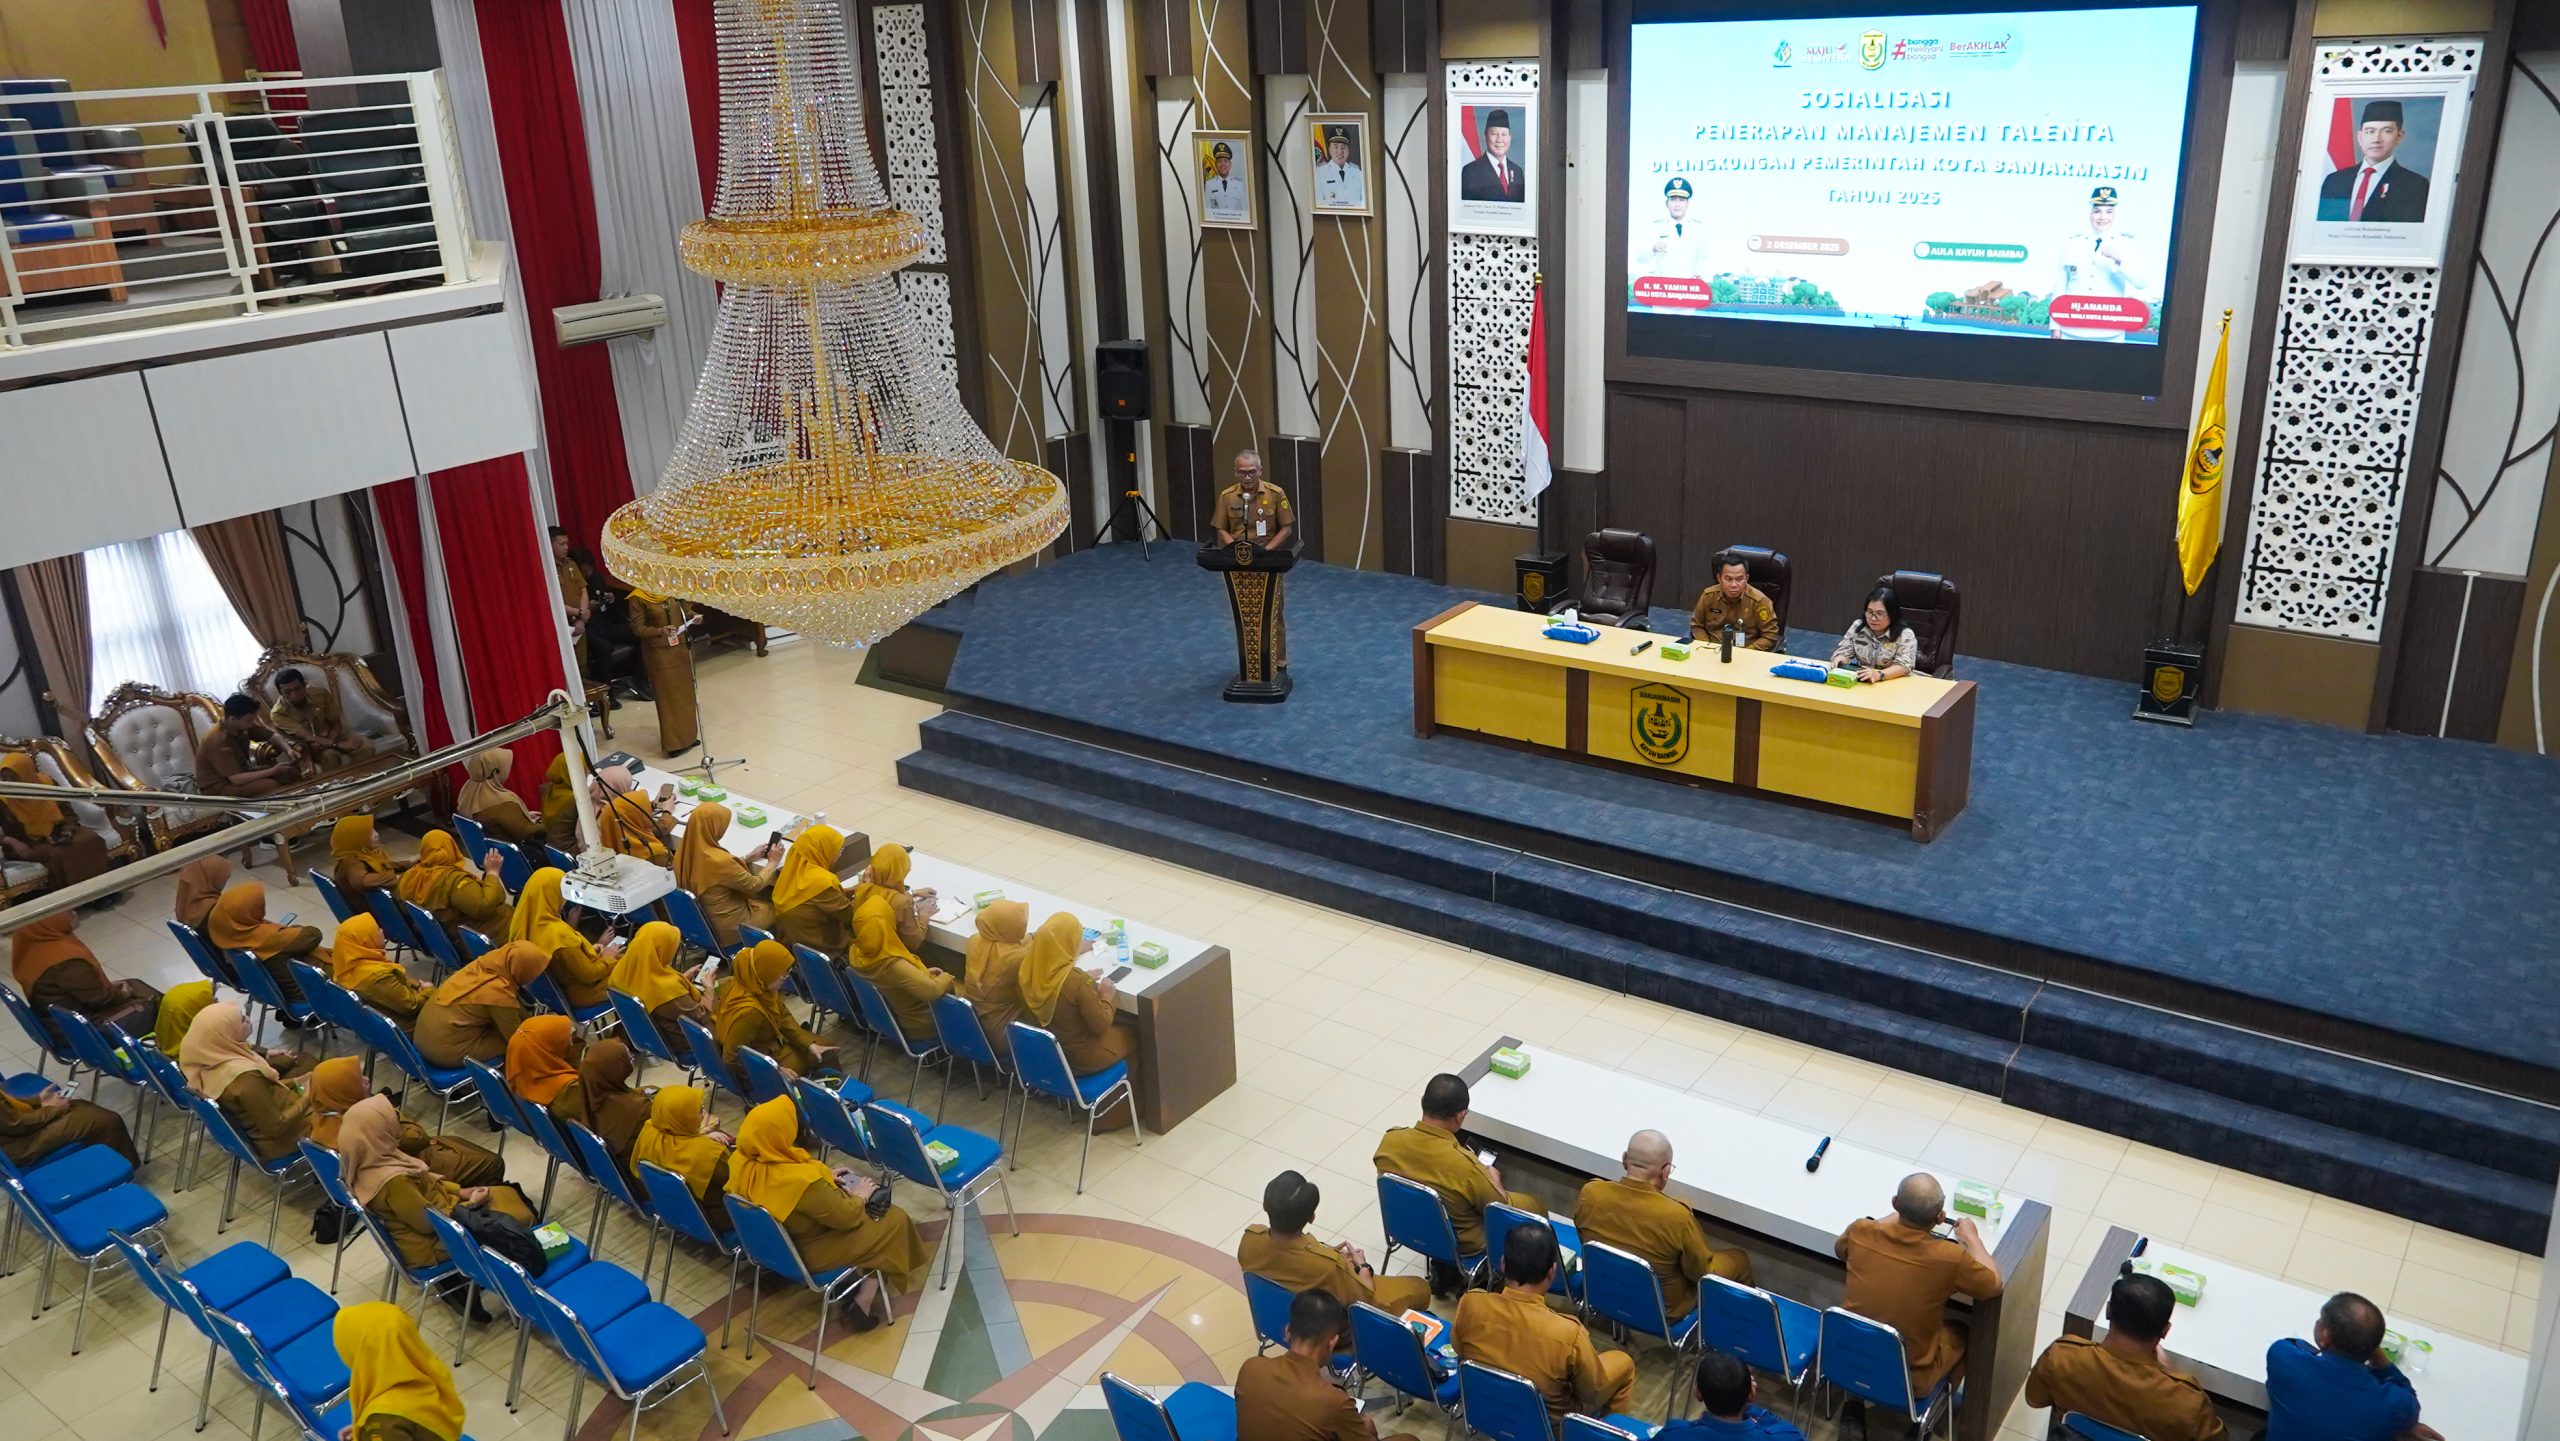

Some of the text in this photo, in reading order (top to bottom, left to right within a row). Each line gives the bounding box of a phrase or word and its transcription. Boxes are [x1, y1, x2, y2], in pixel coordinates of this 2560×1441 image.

[1907, 38, 1939, 46] bangga
[1949, 41, 2007, 51] BerAKHLAK
[1907, 45, 1943, 54] melayani
[1907, 53, 1936, 61] bangsa
[1800, 91, 1950, 109] SOSIALISASI
[1694, 124, 2114, 143] PENERAPAN MANAJEMEN TALENTA
[1651, 156, 2149, 181] DI LINGKUNGAN PEMERINTAH KOTA BANJARMASIN
[1828, 188, 1941, 205] TAHUN 2025
[1766, 240, 1840, 251] 2 DESEMBER 2025
[1930, 247, 1954, 257] AULA
